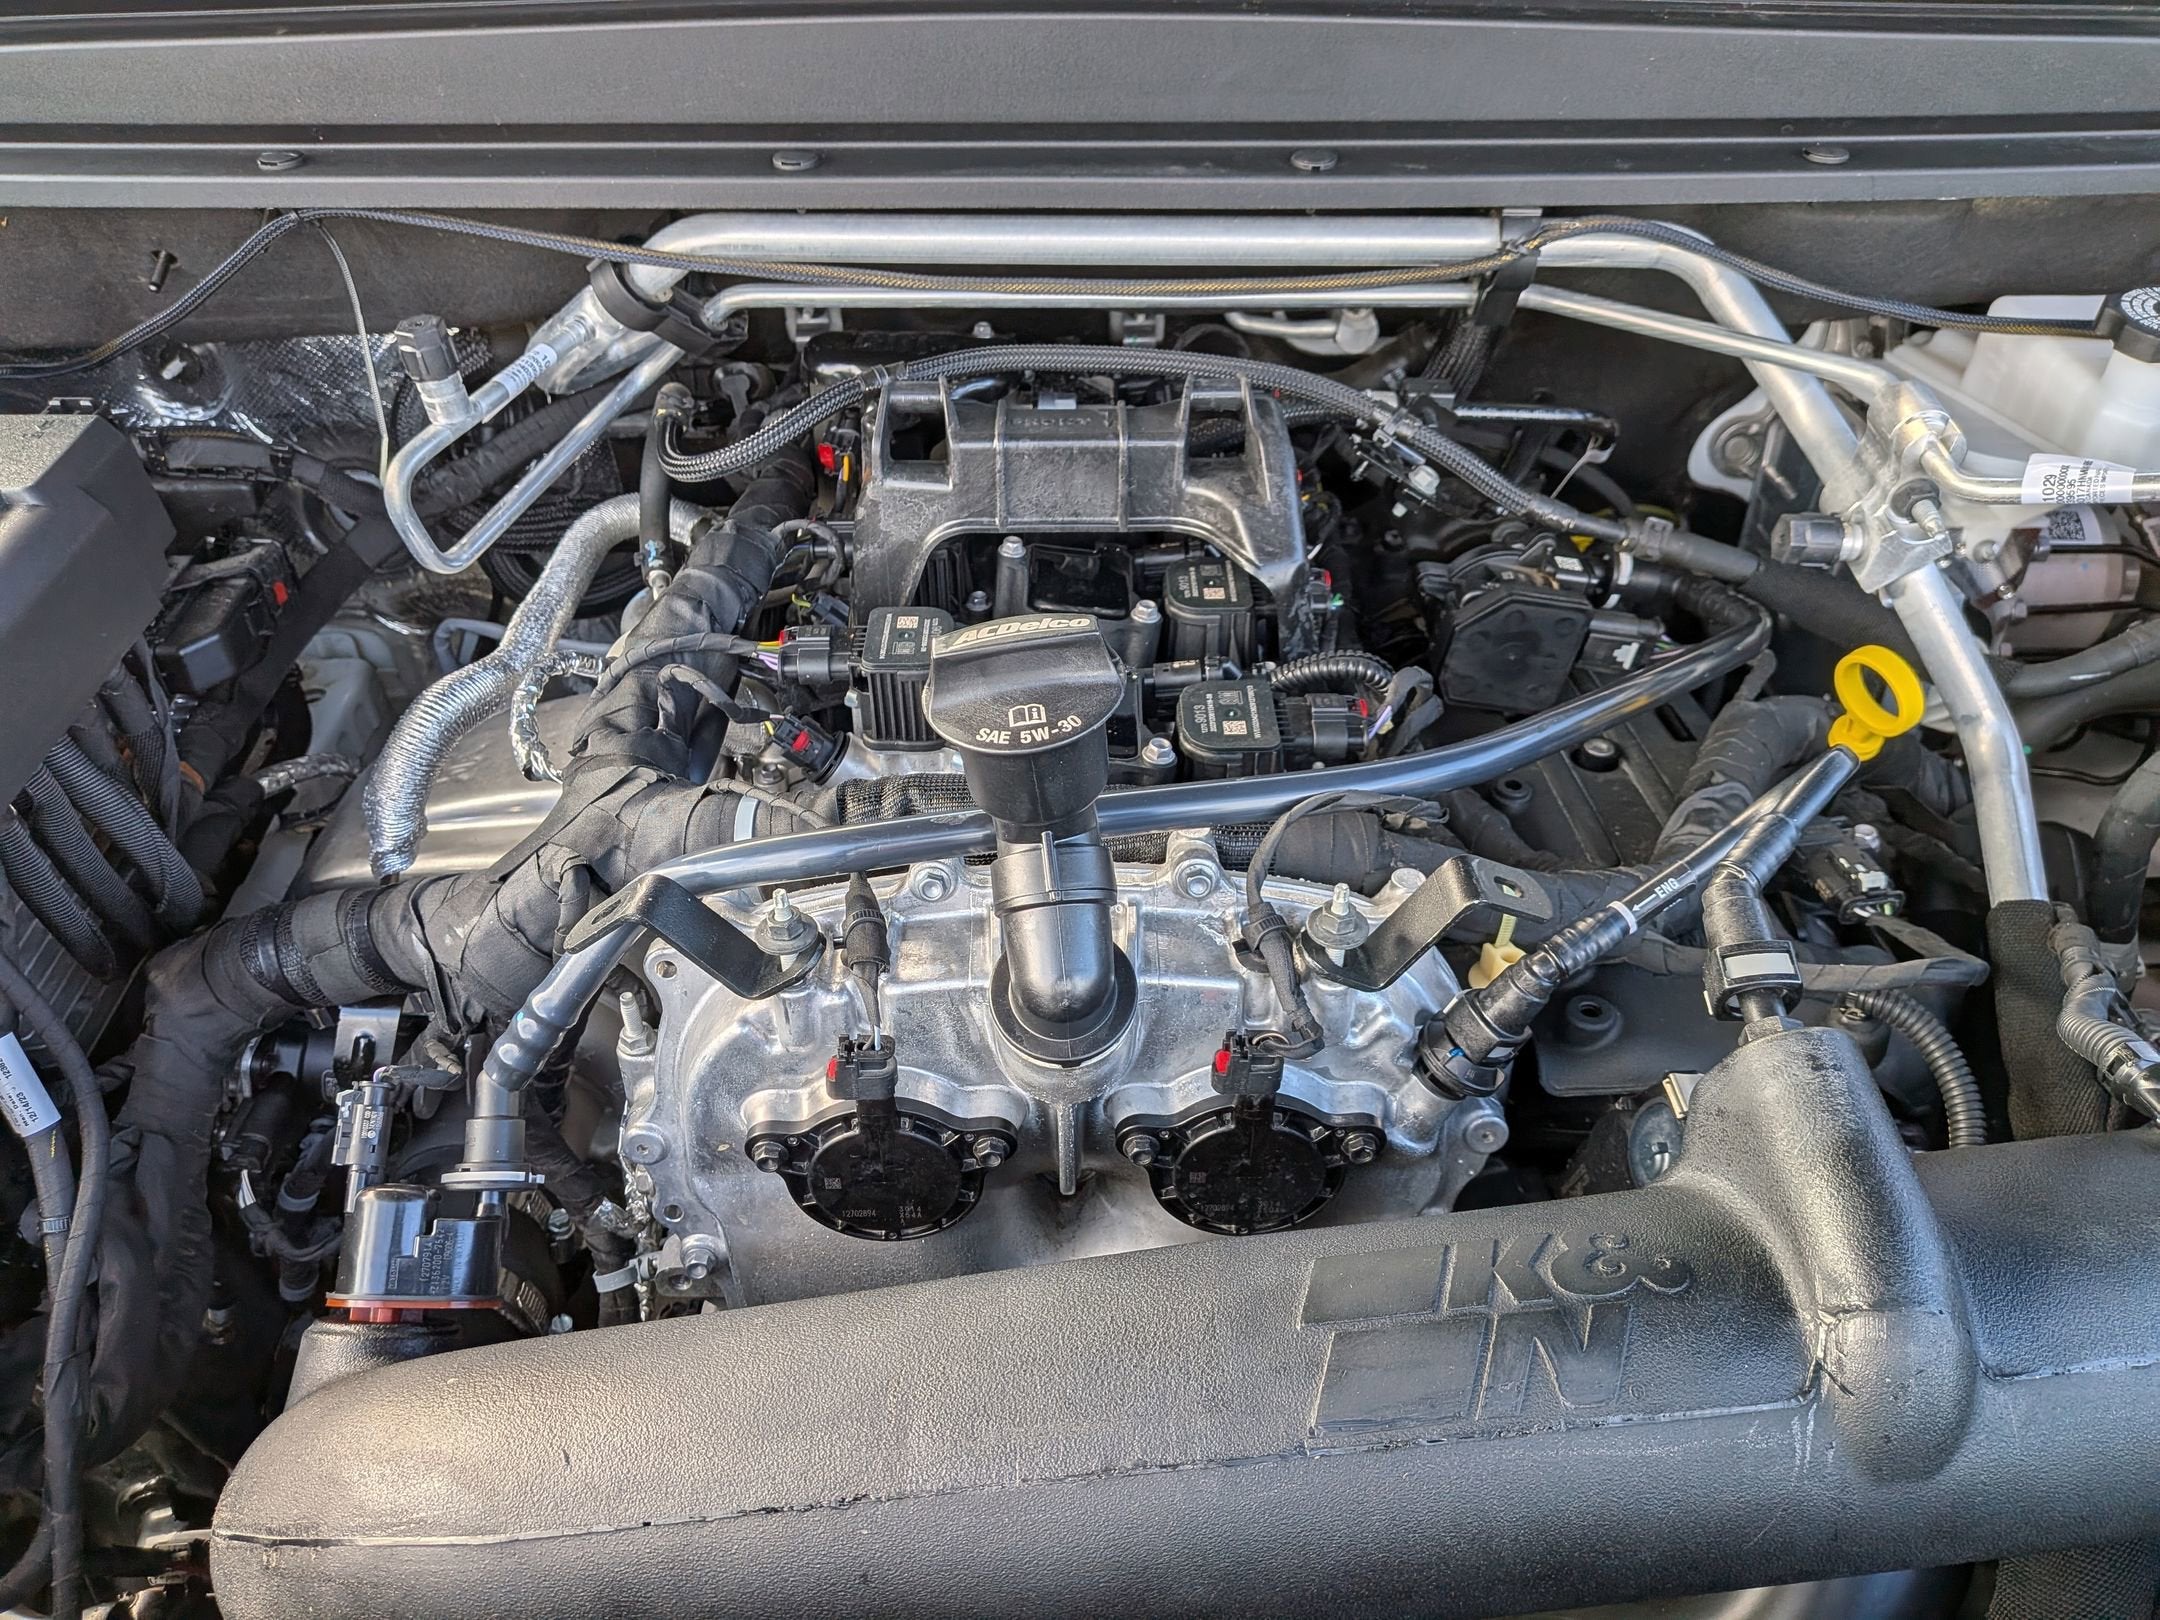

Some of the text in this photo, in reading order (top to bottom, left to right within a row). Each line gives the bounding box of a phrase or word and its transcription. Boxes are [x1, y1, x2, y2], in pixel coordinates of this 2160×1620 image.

[2042, 474, 2057, 502] 1029
[953, 617, 1091, 646] ACDelco
[976, 715, 1082, 745] SAE 5W-30
[1654, 877, 1680, 899] ENG
[16, 1091, 39, 1123] 12/14/23
